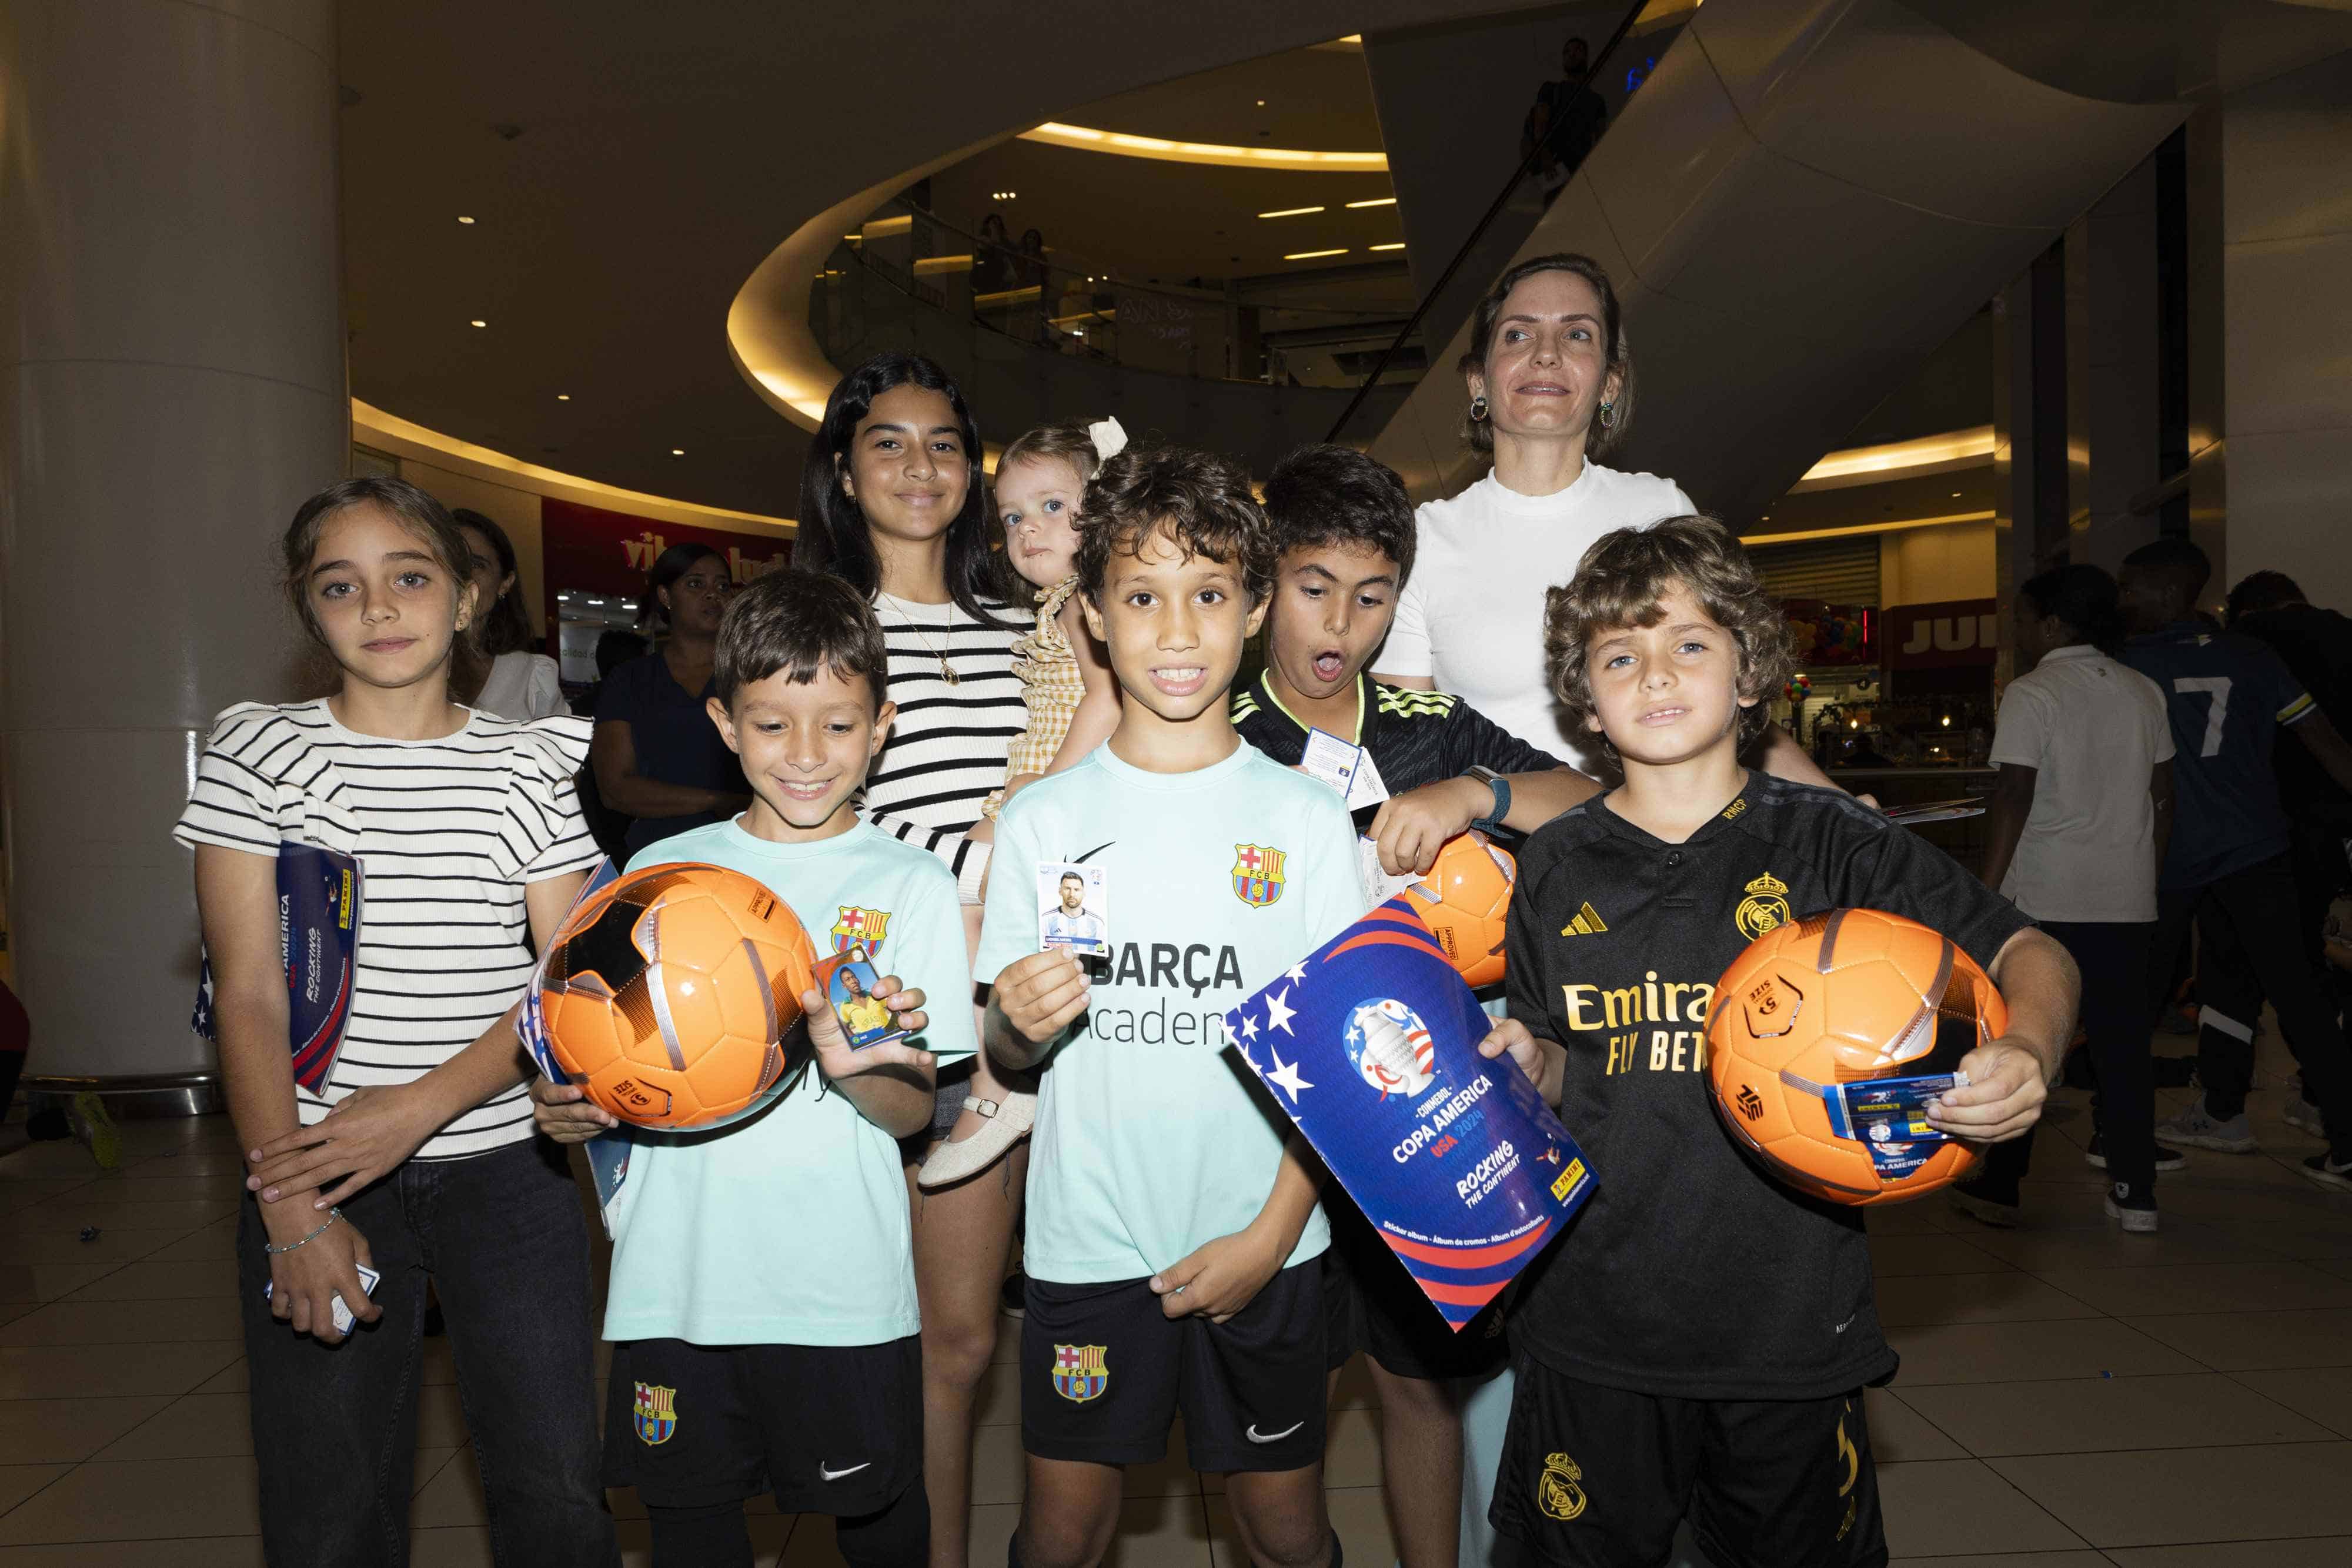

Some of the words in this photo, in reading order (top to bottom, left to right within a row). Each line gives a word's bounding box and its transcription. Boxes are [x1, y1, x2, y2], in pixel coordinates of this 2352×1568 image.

[1902, 614, 1997, 654] JU
[2173, 677, 2233, 757] 7
[1722, 799, 1747, 820] RMCF
[1250, 870, 1270, 880] FCB
[281, 894, 289, 969] AMERICA
[850, 928, 871, 940] FCB
[1444, 928, 1456, 960] APPROVED
[306, 927, 316, 1001] ROCKING
[1091, 942, 1244, 999] BARÇA
[1561, 970, 1713, 1031] Emira
[1749, 979, 1770, 1001] SIZE
[1766, 997, 1776, 1010] 5
[1605, 1031, 1639, 1076] FLY
[1649, 1030, 1708, 1072] BET
[613, 1079, 633, 1095] SIZE
[1392, 1124, 1437, 1164] COPA
[1432, 1074, 1493, 1132] AMERICA
[1429, 1134, 1459, 1158] USA
[1454, 1109, 1485, 1138] 2024
[1456, 1139, 1514, 1199] ROCKING
[1465, 1189, 1484, 1209] THE
[1482, 1153, 1520, 1195] CONTINENT
[1560, 1161, 1581, 1186] PANINI
[1887, 1158, 1927, 1170] AMERICA
[1383, 1220, 1408, 1235] Sticker
[1407, 1230, 1428, 1242] album
[1454, 1237, 1464, 1246] de
[1464, 1238, 1487, 1246] cromos
